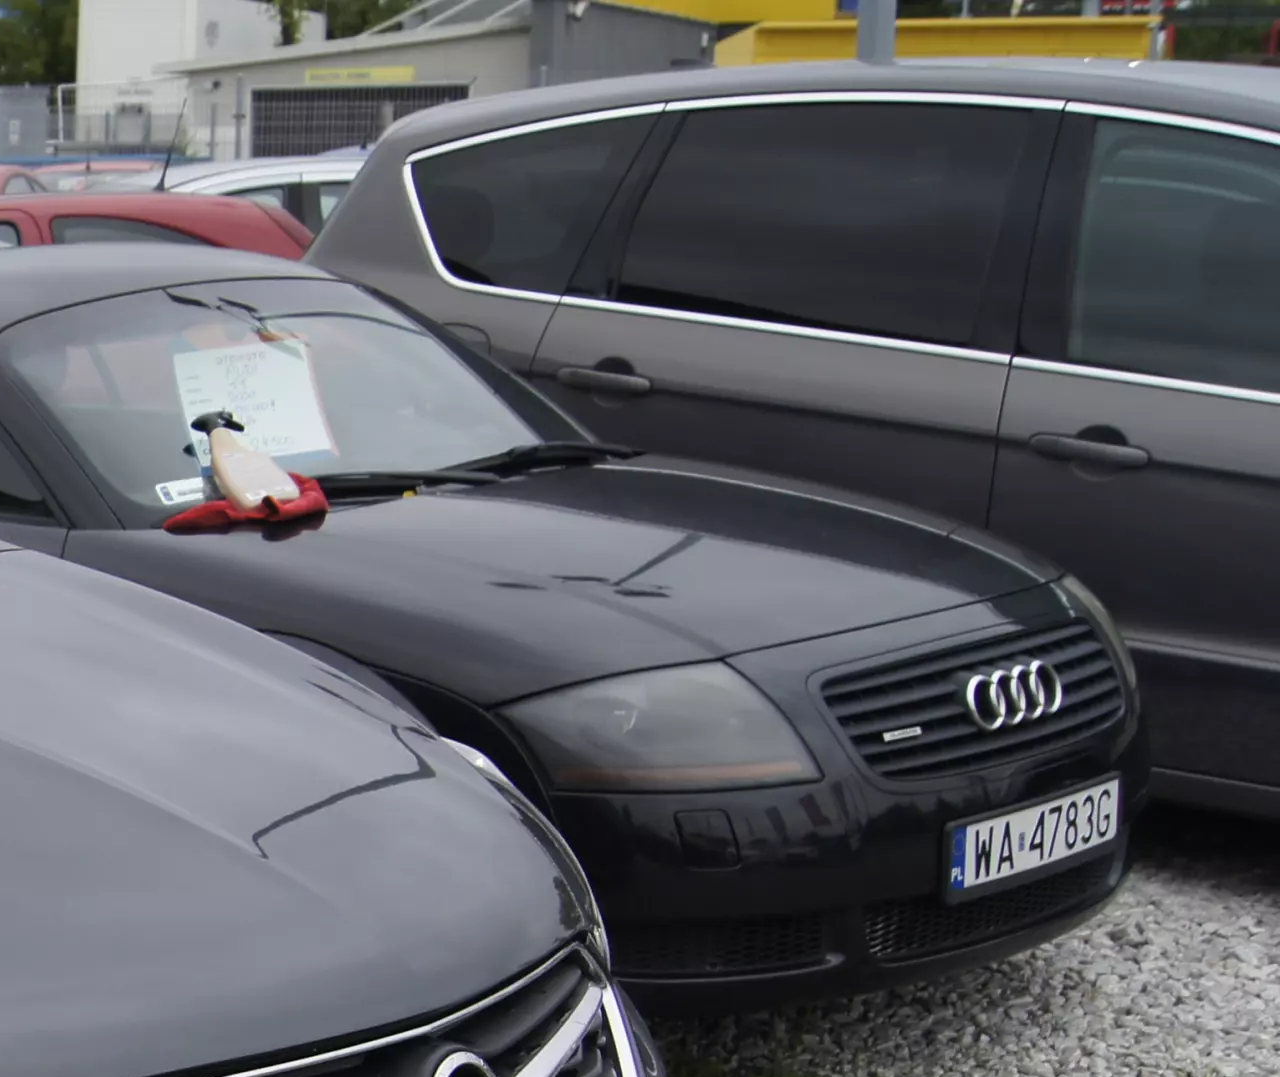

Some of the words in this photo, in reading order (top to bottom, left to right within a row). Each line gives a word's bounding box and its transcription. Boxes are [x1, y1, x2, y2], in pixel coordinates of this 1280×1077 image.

[974, 821, 1015, 881] WA
[1028, 789, 1112, 863] 4783G
[950, 867, 964, 883] PL
